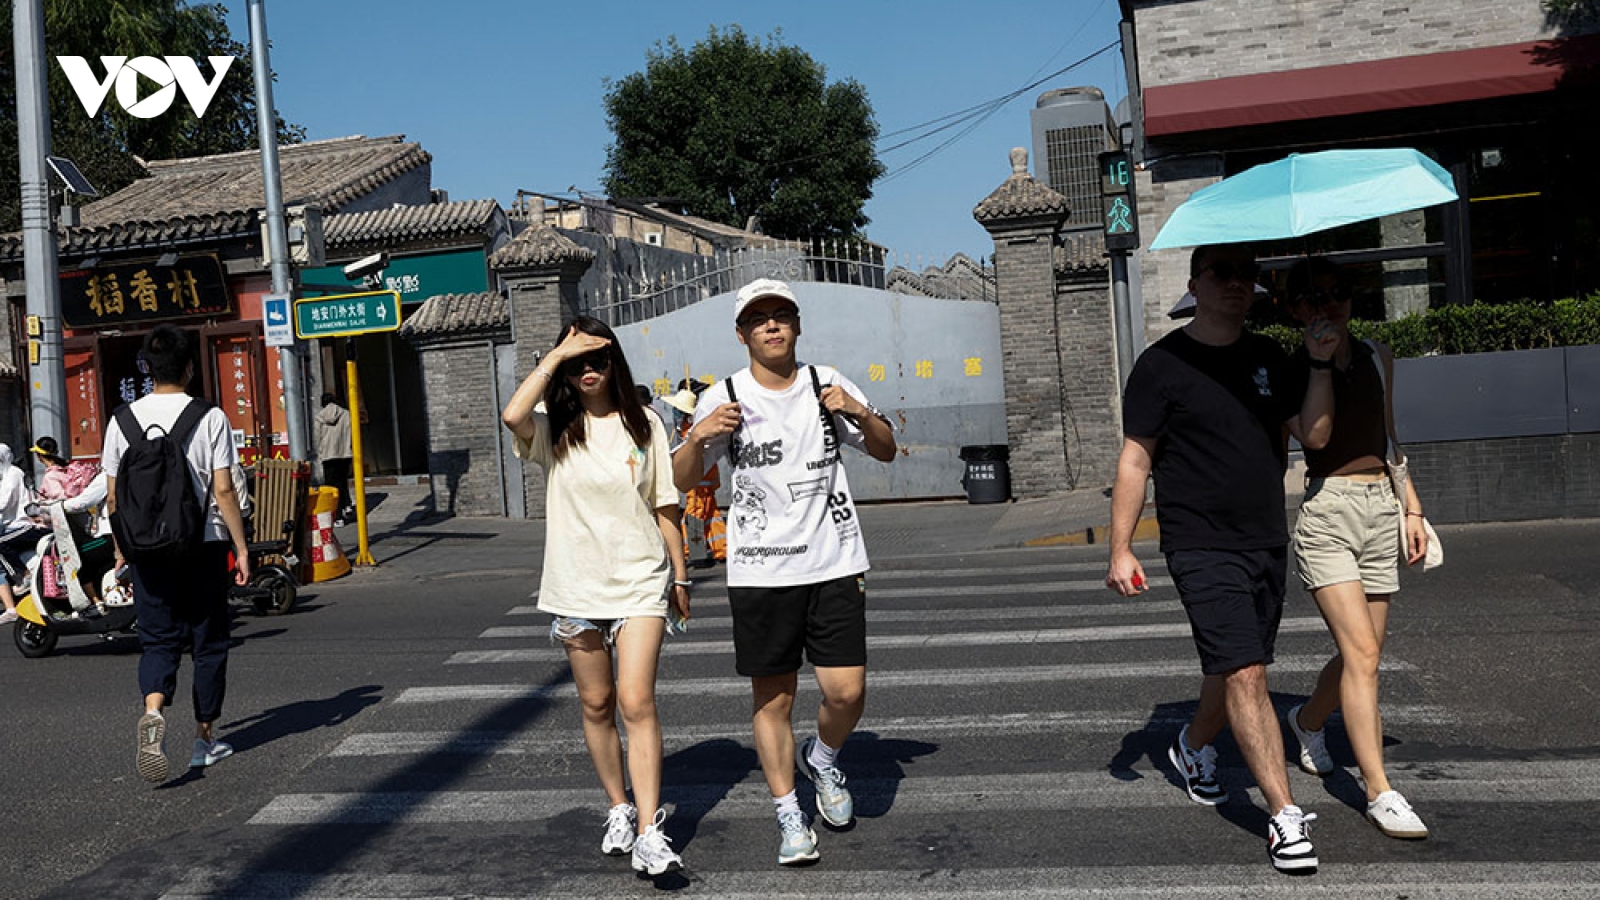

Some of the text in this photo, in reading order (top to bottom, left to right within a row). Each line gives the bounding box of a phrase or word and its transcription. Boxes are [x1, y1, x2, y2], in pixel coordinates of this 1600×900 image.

[1109, 160, 1129, 185] 16
[85, 268, 200, 317] 稻香村
[311, 302, 366, 321] 地安门外大街
